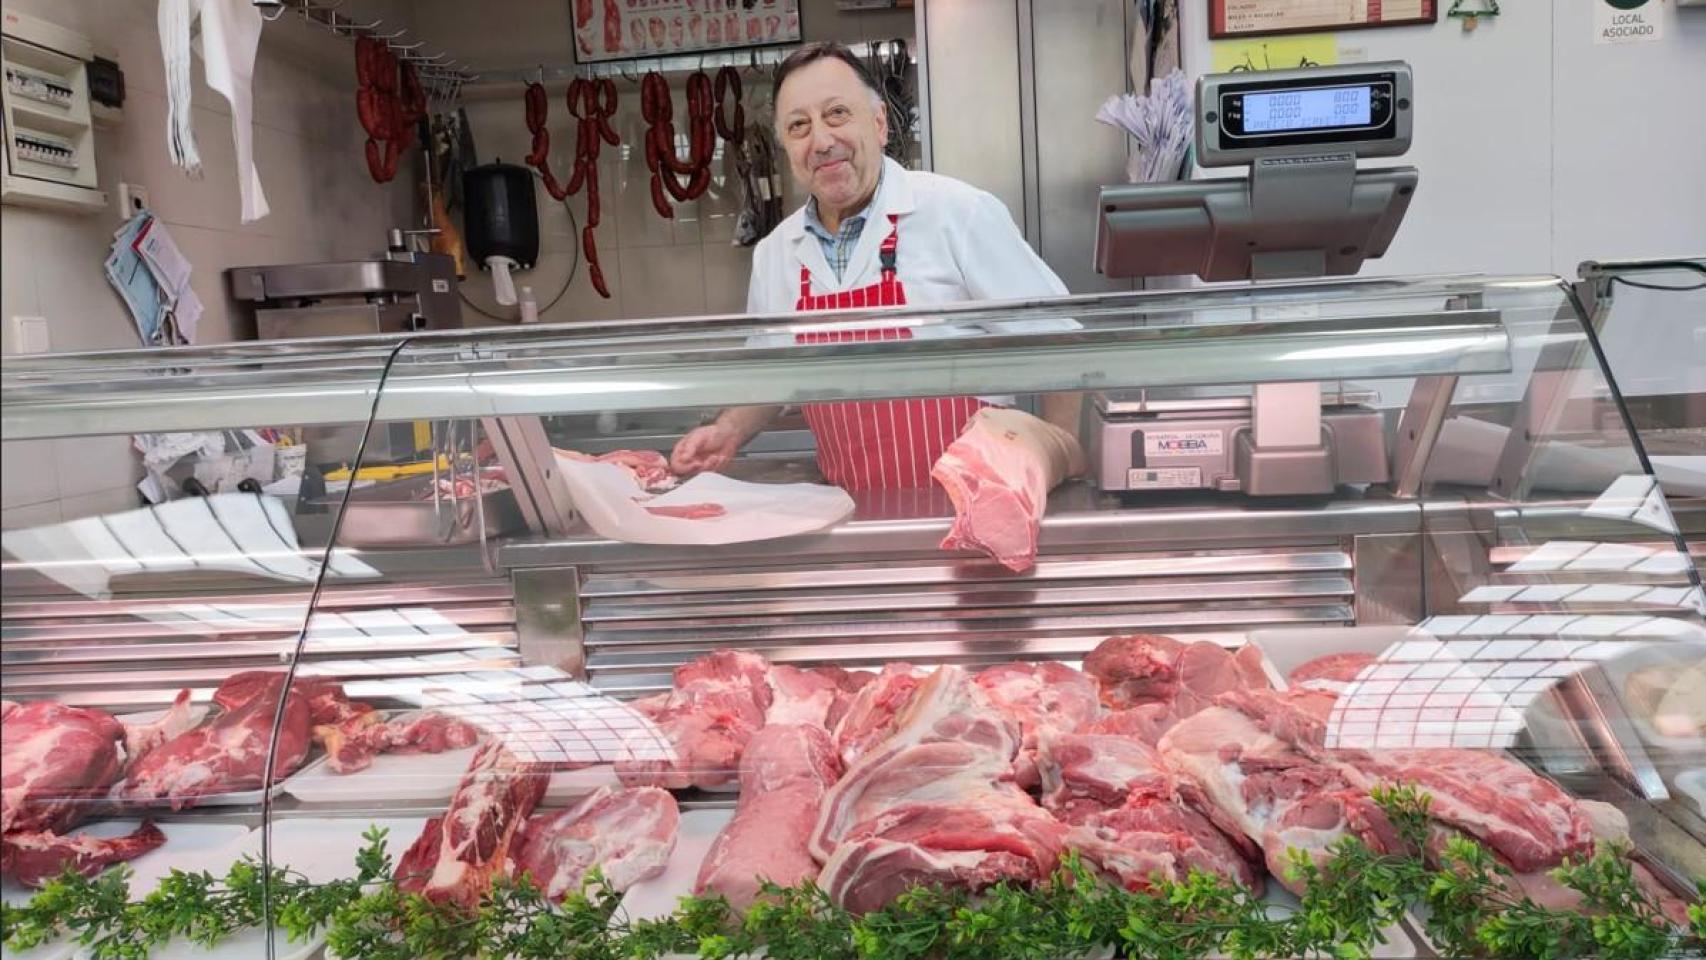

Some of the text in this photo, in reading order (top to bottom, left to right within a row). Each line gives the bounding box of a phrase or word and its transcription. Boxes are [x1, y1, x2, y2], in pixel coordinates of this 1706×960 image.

[1612, 13, 1644, 25] LOCAL
[1602, 25, 1654, 38] ASOCIADO
[1158, 439, 1207, 450] MOBBA
